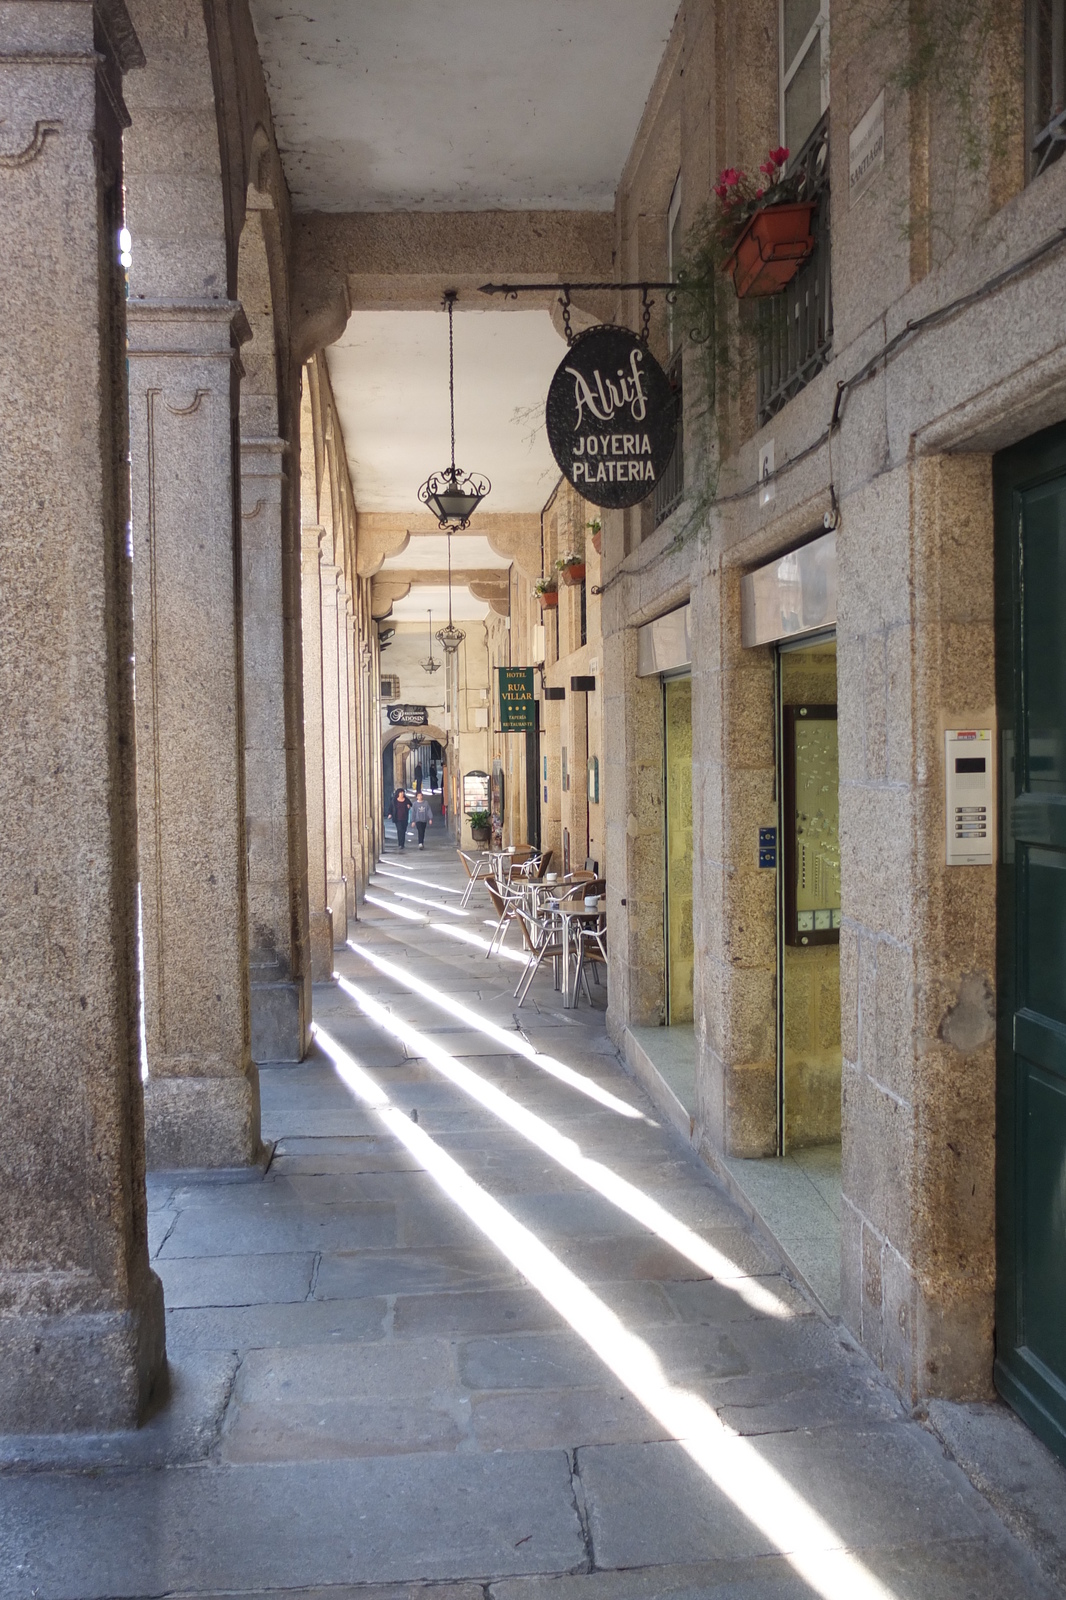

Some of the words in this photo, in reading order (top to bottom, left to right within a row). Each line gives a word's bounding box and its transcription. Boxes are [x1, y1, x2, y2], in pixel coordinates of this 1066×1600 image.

[572, 434, 652, 456] JOYERIA
[573, 461, 656, 483] PLATERIA
[507, 683, 526, 692] RUA
[501, 692, 533, 701] VILLAR
